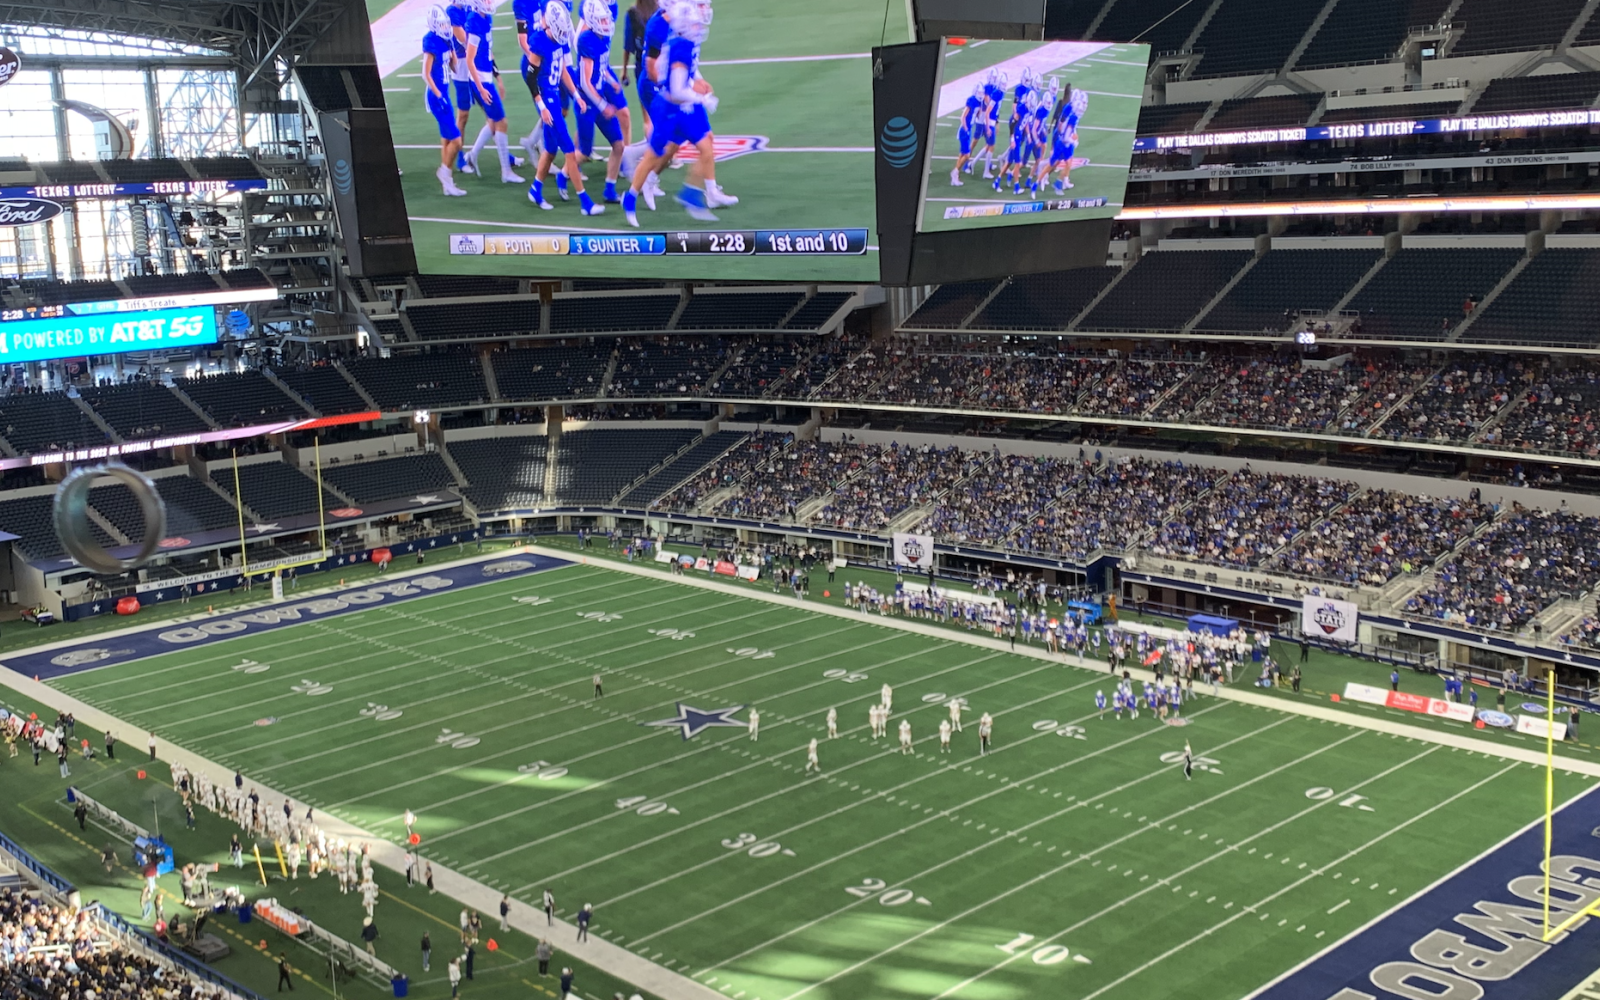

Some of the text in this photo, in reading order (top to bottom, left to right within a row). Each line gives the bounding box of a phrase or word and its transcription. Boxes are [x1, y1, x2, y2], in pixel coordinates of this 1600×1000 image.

[1328, 121, 1415, 139] TEXAS LOTTERY
[1440, 119, 1461, 131] PLAY
[1462, 118, 1478, 130] THE
[1478, 116, 1509, 129] DALLAS
[1509, 114, 1549, 128] COWBOYS
[1550, 111, 1588, 126] SCRATCH
[1157, 136, 1175, 148] PLAY
[1175, 136, 1188, 147] THE
[1189, 133, 1215, 147] DALLAS
[1215, 131, 1247, 145] COWBOYS
[1247, 129, 1279, 143] SCRATCH
[34, 184, 116, 198] TEXAS LOTTERY
[152, 180, 228, 193] TEXAS LOTTERY
[1011, 204, 1033, 214] GUNTER
[490, 243, 497, 254] 3
[504, 239, 532, 254] POTH
[552, 239, 560, 251] 0
[576, 243, 583, 254] 3
[588, 238, 641, 253] GUNTER
[646, 237, 654, 252] 7
[680, 240, 687, 252] 1
[709, 234, 746, 252] 2:28
[769, 232, 848, 252] 1st and 10
[125, 300, 147, 310] Tiff's
[149, 298, 177, 308] Treats
[2, 309, 24, 321] 2:28
[13, 328, 84, 350] POWERED
[88, 326, 105, 344] BY
[110, 318, 166, 343] AT&T
[168, 315, 204, 338] 5G
[31, 453, 64, 466] WELCOME
[65, 451, 75, 462] TO
[76, 449, 88, 460] THE
[121, 441, 152, 454] FOOTBALL
[902, 546, 925, 558] STATE
[157, 575, 199, 588] WELCOME
[215, 570, 230, 578] THE
[158, 575, 453, 643] COWBOYS
[1314, 612, 1345, 628] STATE
[518, 760, 568, 781] 50
[615, 795, 667, 816] 40
[1305, 786, 1369, 808] 10
[721, 832, 782, 858] 30
[844, 878, 914, 906] 20
[1325, 855, 1600, 1000] COWBO
[994, 932, 1070, 965] 10
